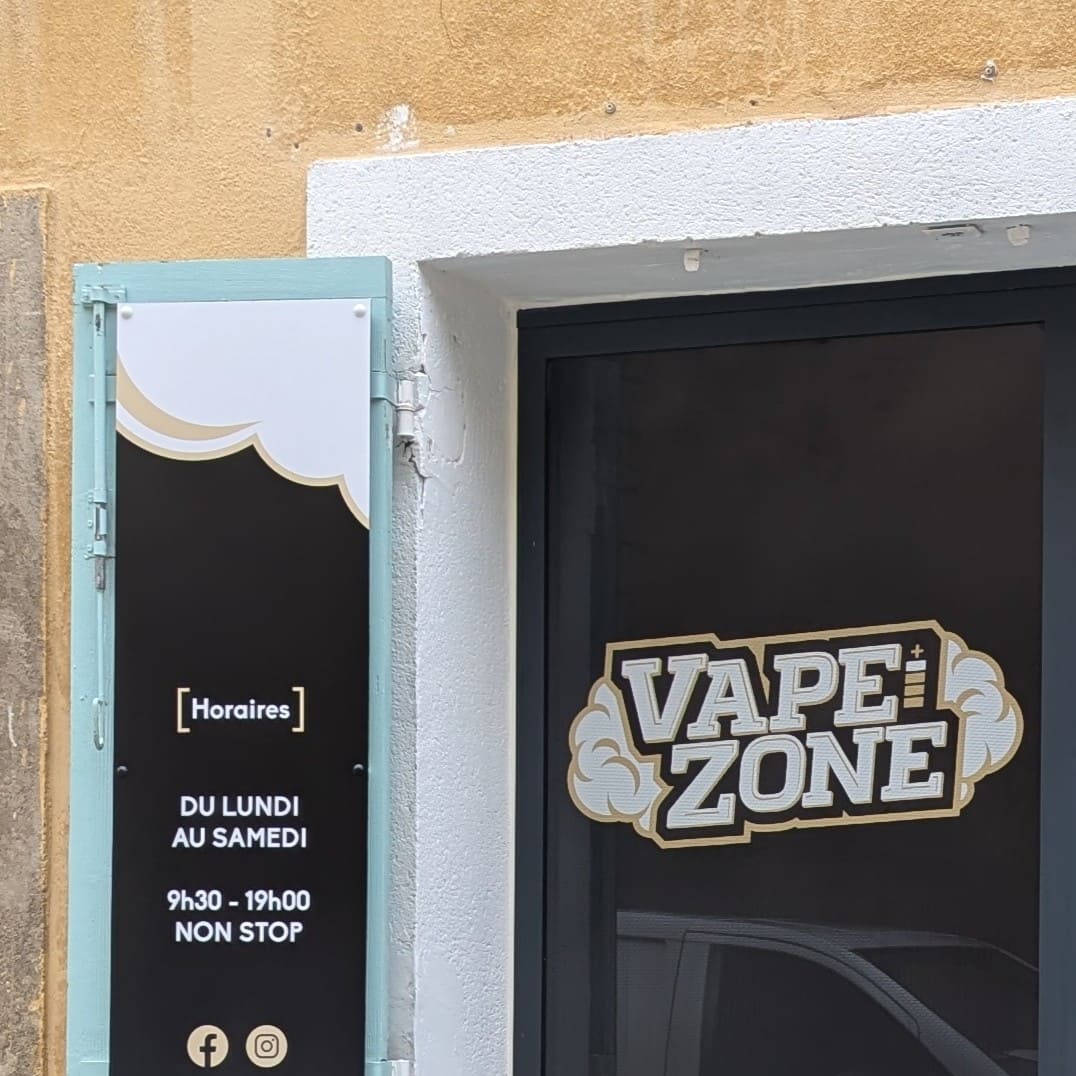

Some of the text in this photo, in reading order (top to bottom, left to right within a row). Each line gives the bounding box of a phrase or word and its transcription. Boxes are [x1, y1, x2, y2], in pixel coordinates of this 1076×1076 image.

[621, 643, 902, 744] VAPE
[665, 721, 948, 830] ZONE
[180, 795, 299, 817] DU LUNDI
[171, 827, 307, 848] AU SAMEDI
[167, 889, 222, 911] 9h30
[244, 889, 311, 911] 19h00
[175, 920, 304, 943] NON STOP
